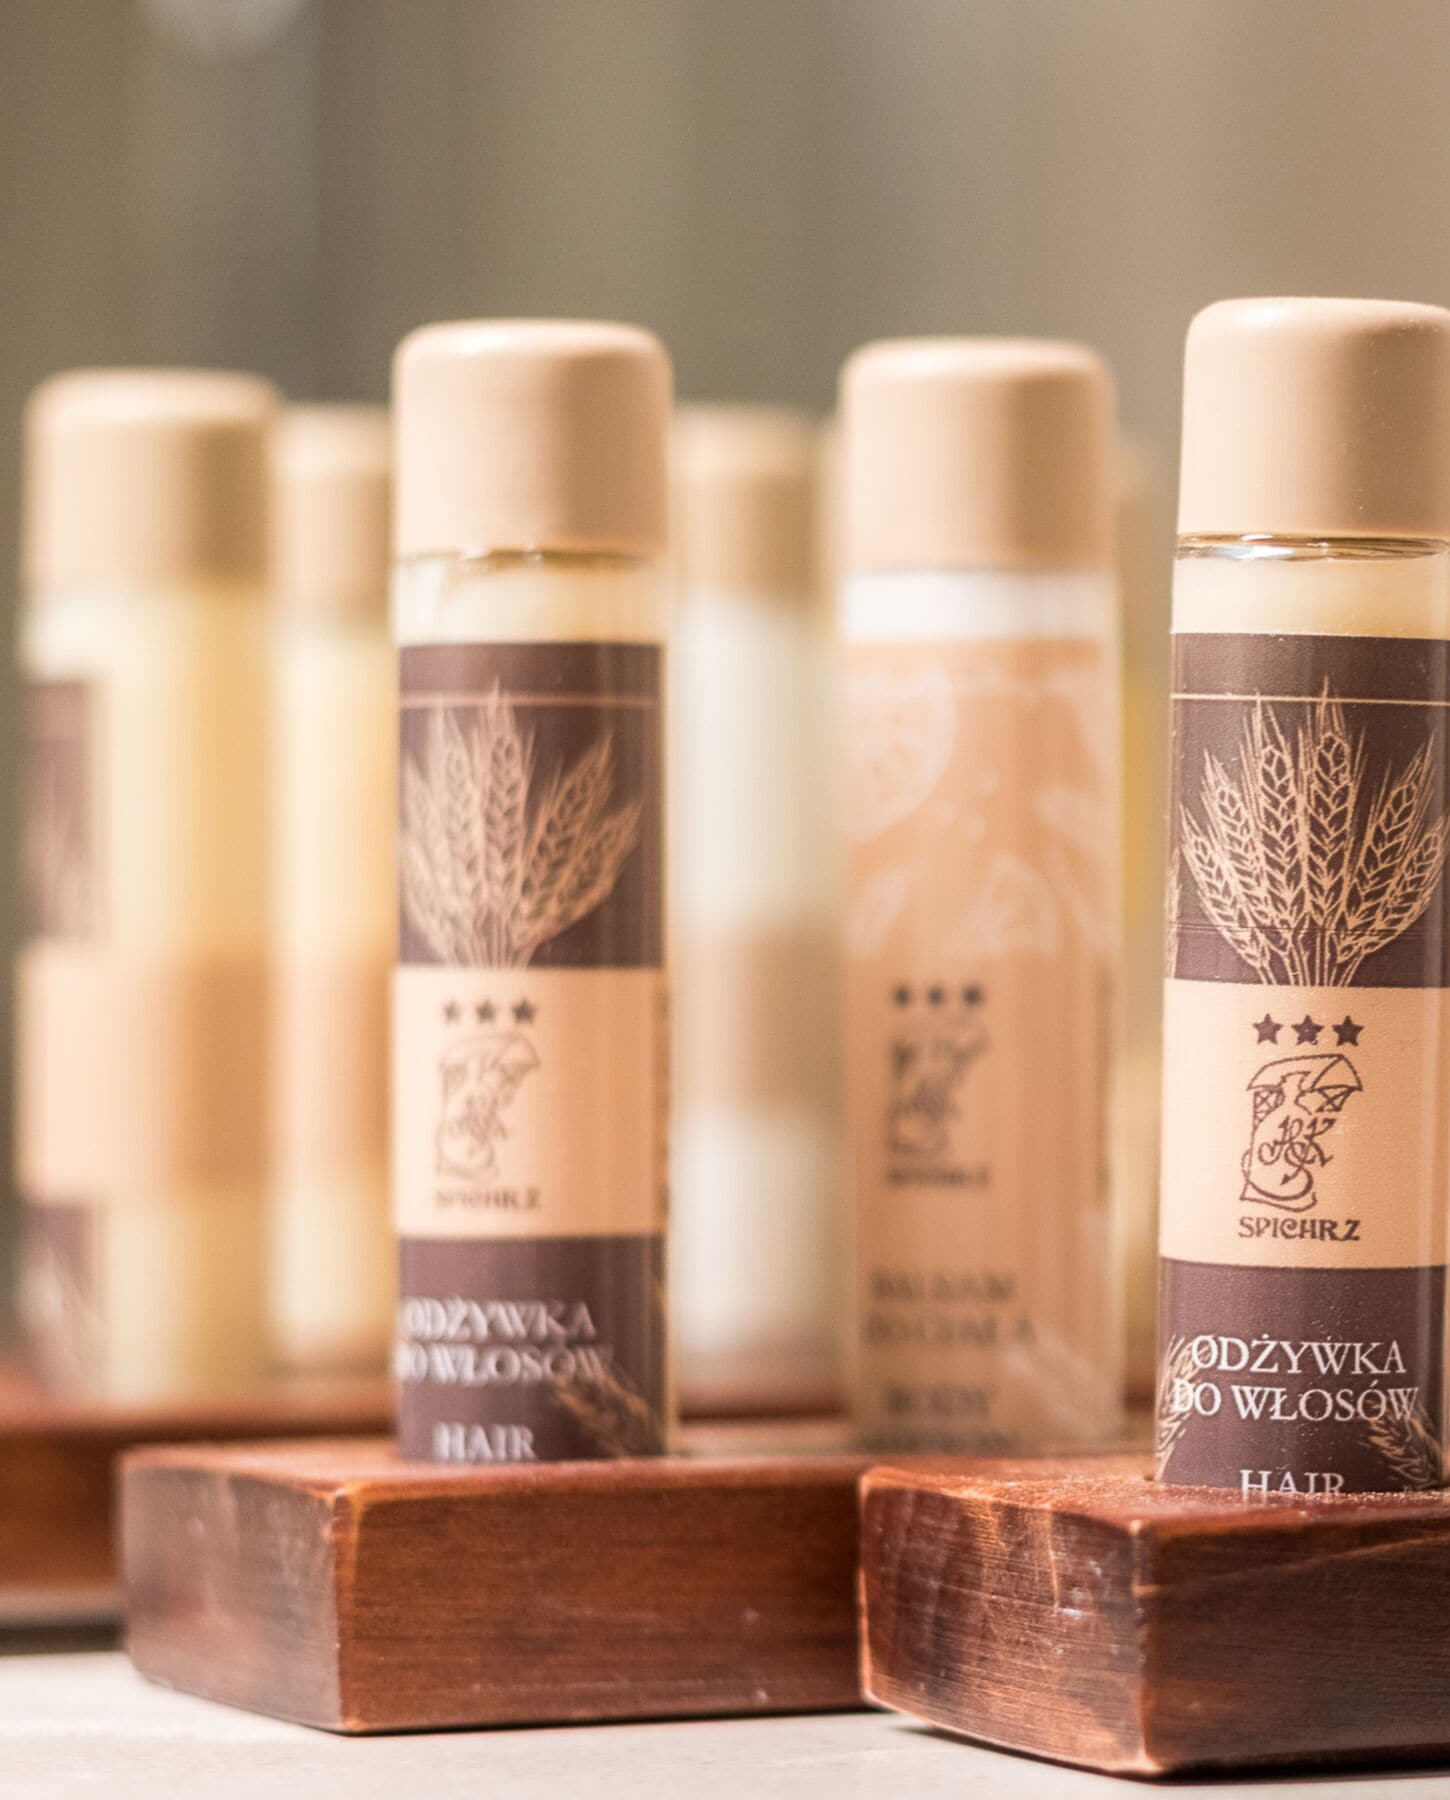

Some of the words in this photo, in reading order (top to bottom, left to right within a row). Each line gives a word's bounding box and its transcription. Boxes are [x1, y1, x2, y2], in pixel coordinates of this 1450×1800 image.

[1237, 1216, 1361, 1241] SPICHRZ
[1190, 1334, 1407, 1375] ODŻYWKA
[1172, 1378, 1222, 1417] DO
[1231, 1379, 1420, 1421] WŁOSÓW
[433, 1421, 540, 1462] HAIR
[1239, 1469, 1344, 1496] HAIR
